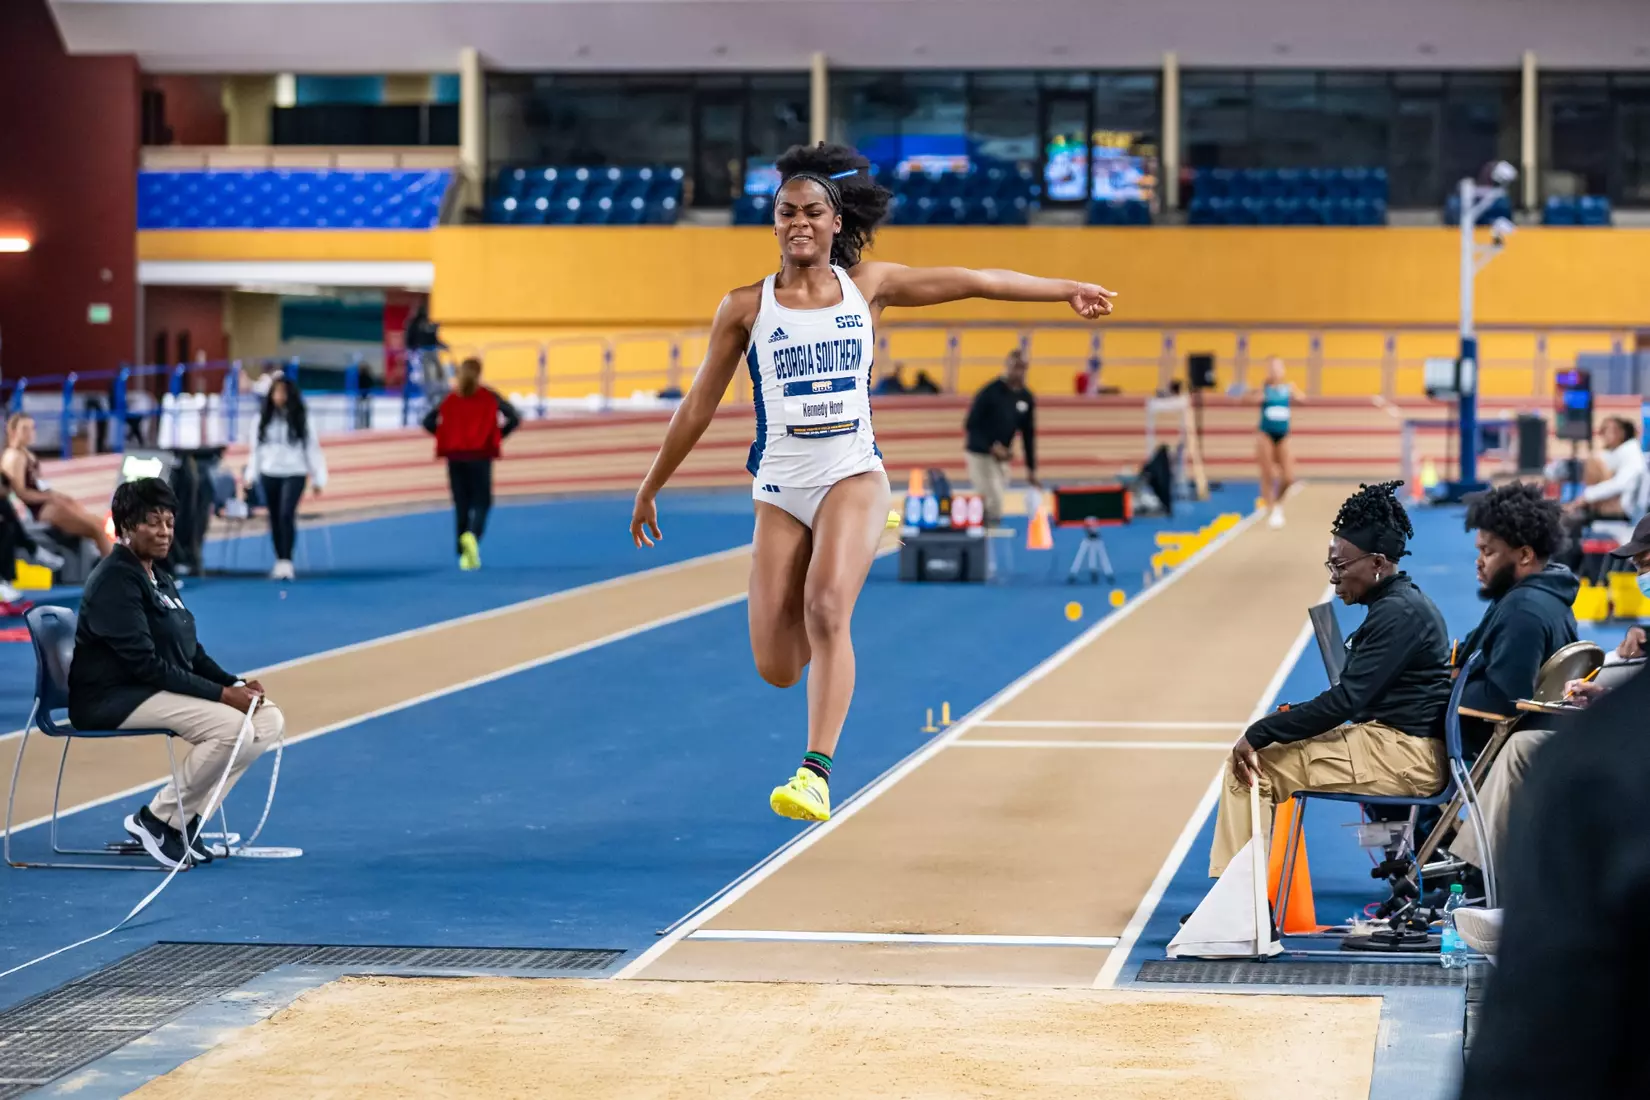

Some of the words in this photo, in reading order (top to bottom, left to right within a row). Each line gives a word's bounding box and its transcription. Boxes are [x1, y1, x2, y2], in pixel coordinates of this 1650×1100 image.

[835, 314, 863, 329] SBC
[768, 334, 789, 344] adidas
[773, 343, 815, 380] GEORGIA
[815, 338, 863, 374] SOUTHERN
[802, 401, 828, 418] Kennedy
